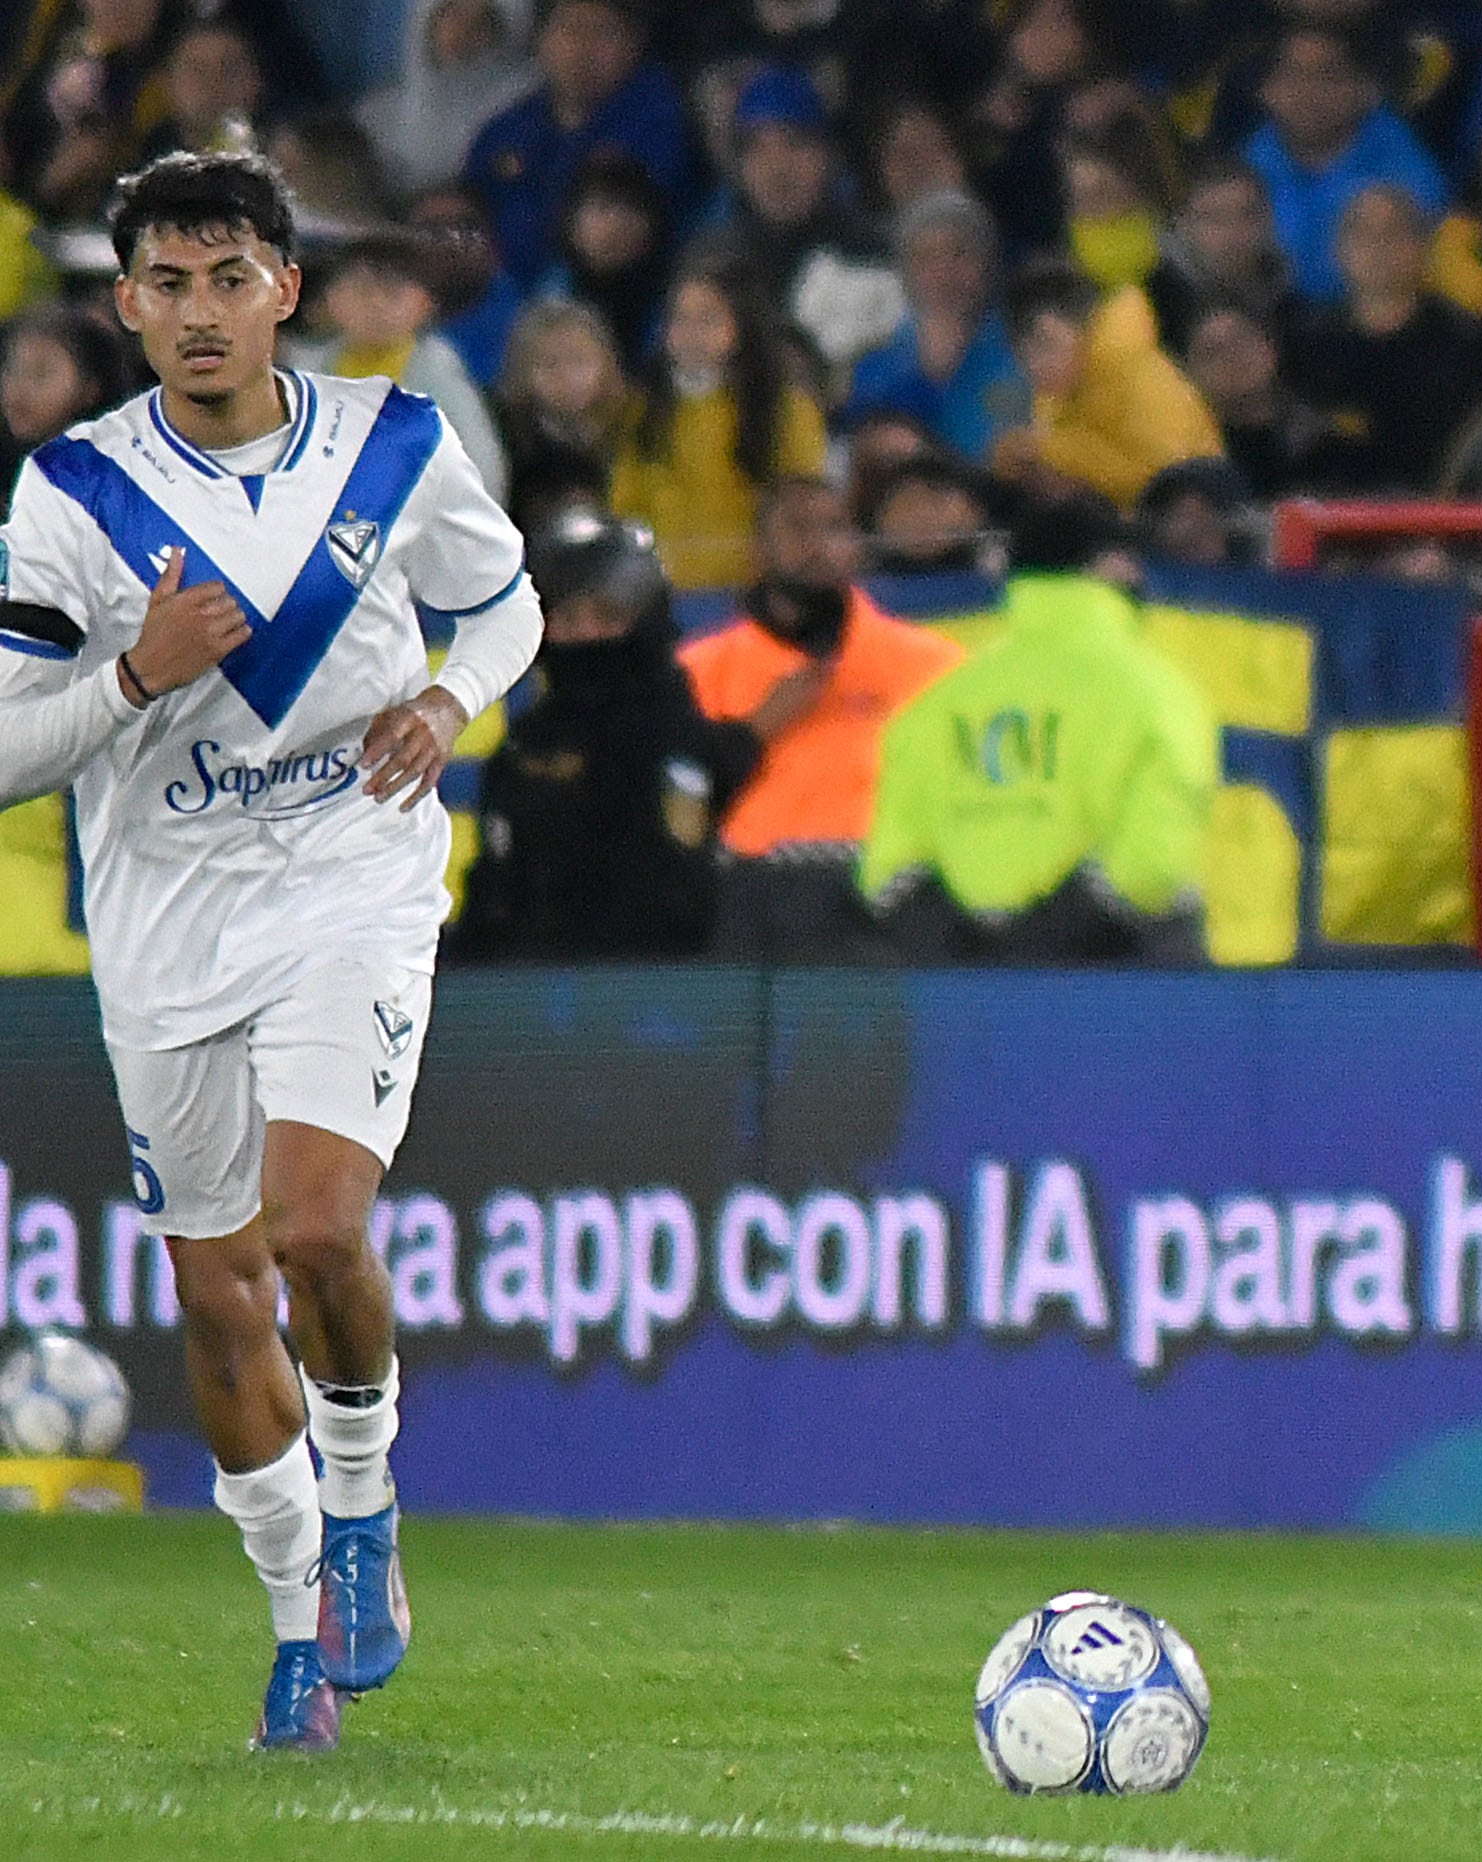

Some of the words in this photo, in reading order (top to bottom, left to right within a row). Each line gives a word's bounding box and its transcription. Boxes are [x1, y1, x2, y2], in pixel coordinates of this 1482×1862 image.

[480, 1190, 700, 1364] app
[717, 1191, 949, 1327] con
[976, 1162, 1110, 1328] IA
[1130, 1196, 1412, 1370] para
